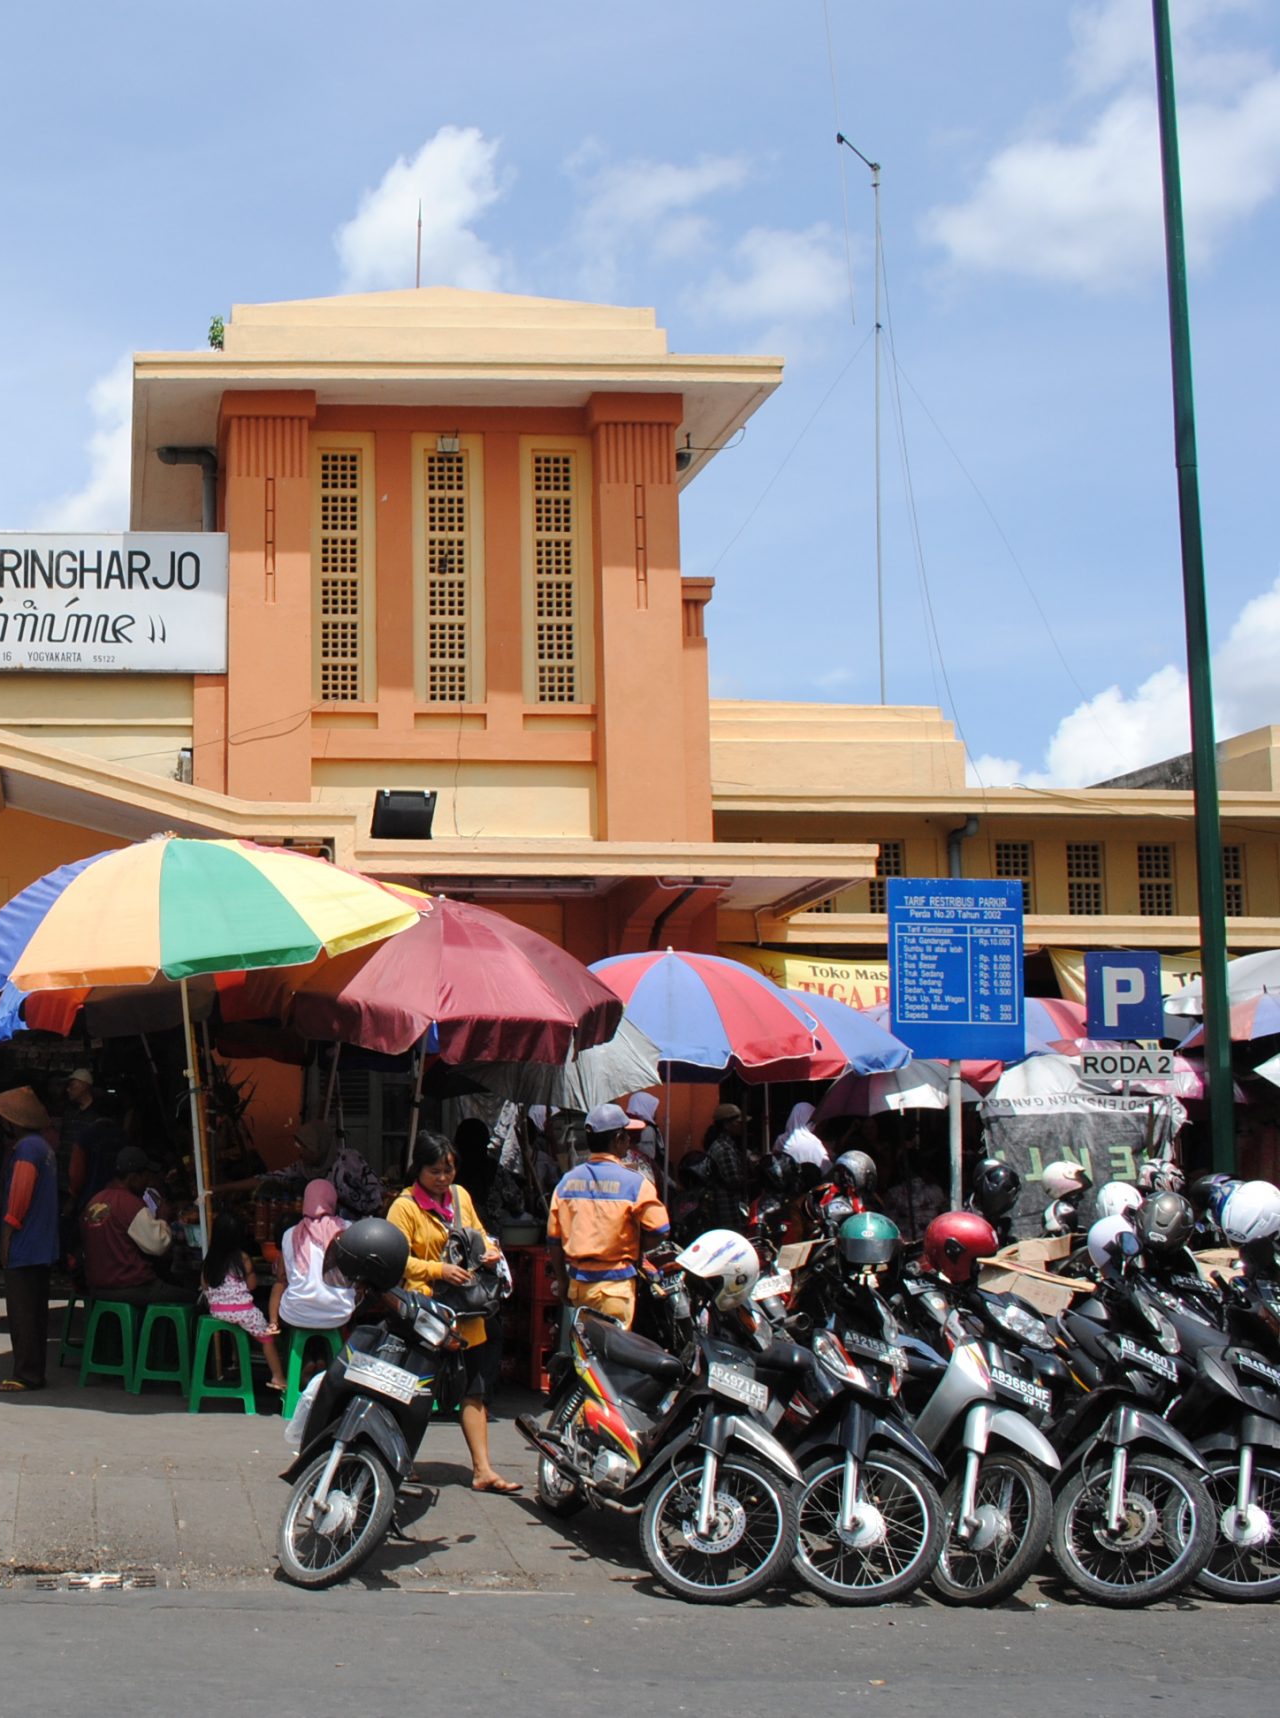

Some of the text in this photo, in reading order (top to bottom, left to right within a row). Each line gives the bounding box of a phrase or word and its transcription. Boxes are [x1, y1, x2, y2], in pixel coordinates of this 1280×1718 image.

[2, 651, 12, 662] 16
[27, 651, 82, 662] YOGYAKARTA
[92, 655, 115, 663] 55122
[904, 896, 1007, 907] TARIF RESTRIBUSI PARKIR
[910, 910, 931, 918] Perda
[958, 910, 980, 919] Tahun
[983, 911, 1001, 919] 2002
[994, 927, 1011, 935] Parkir
[808, 965, 888, 980] Toko Mas
[1102, 966, 1145, 1027] P
[1083, 1056, 1171, 1074] RODA 2
